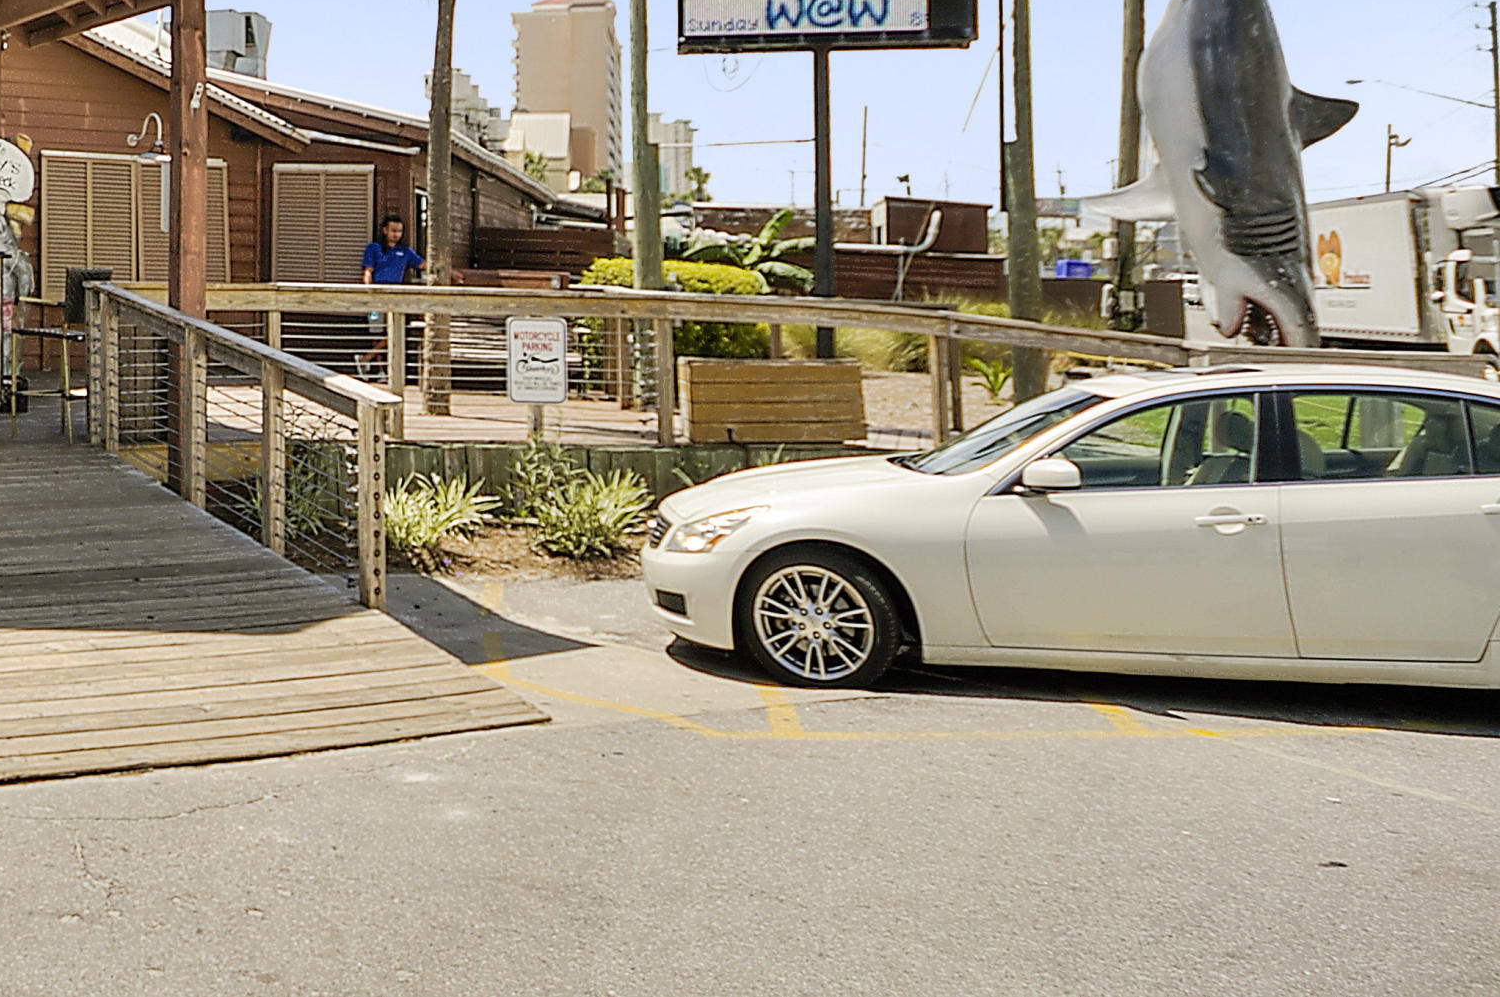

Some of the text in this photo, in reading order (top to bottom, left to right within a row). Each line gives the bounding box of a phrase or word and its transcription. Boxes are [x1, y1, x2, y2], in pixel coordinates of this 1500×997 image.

[687, 18, 759, 32] Sunday
[513, 332, 561, 342] MOTORCYCLE
[521, 342, 553, 352] PARKING
